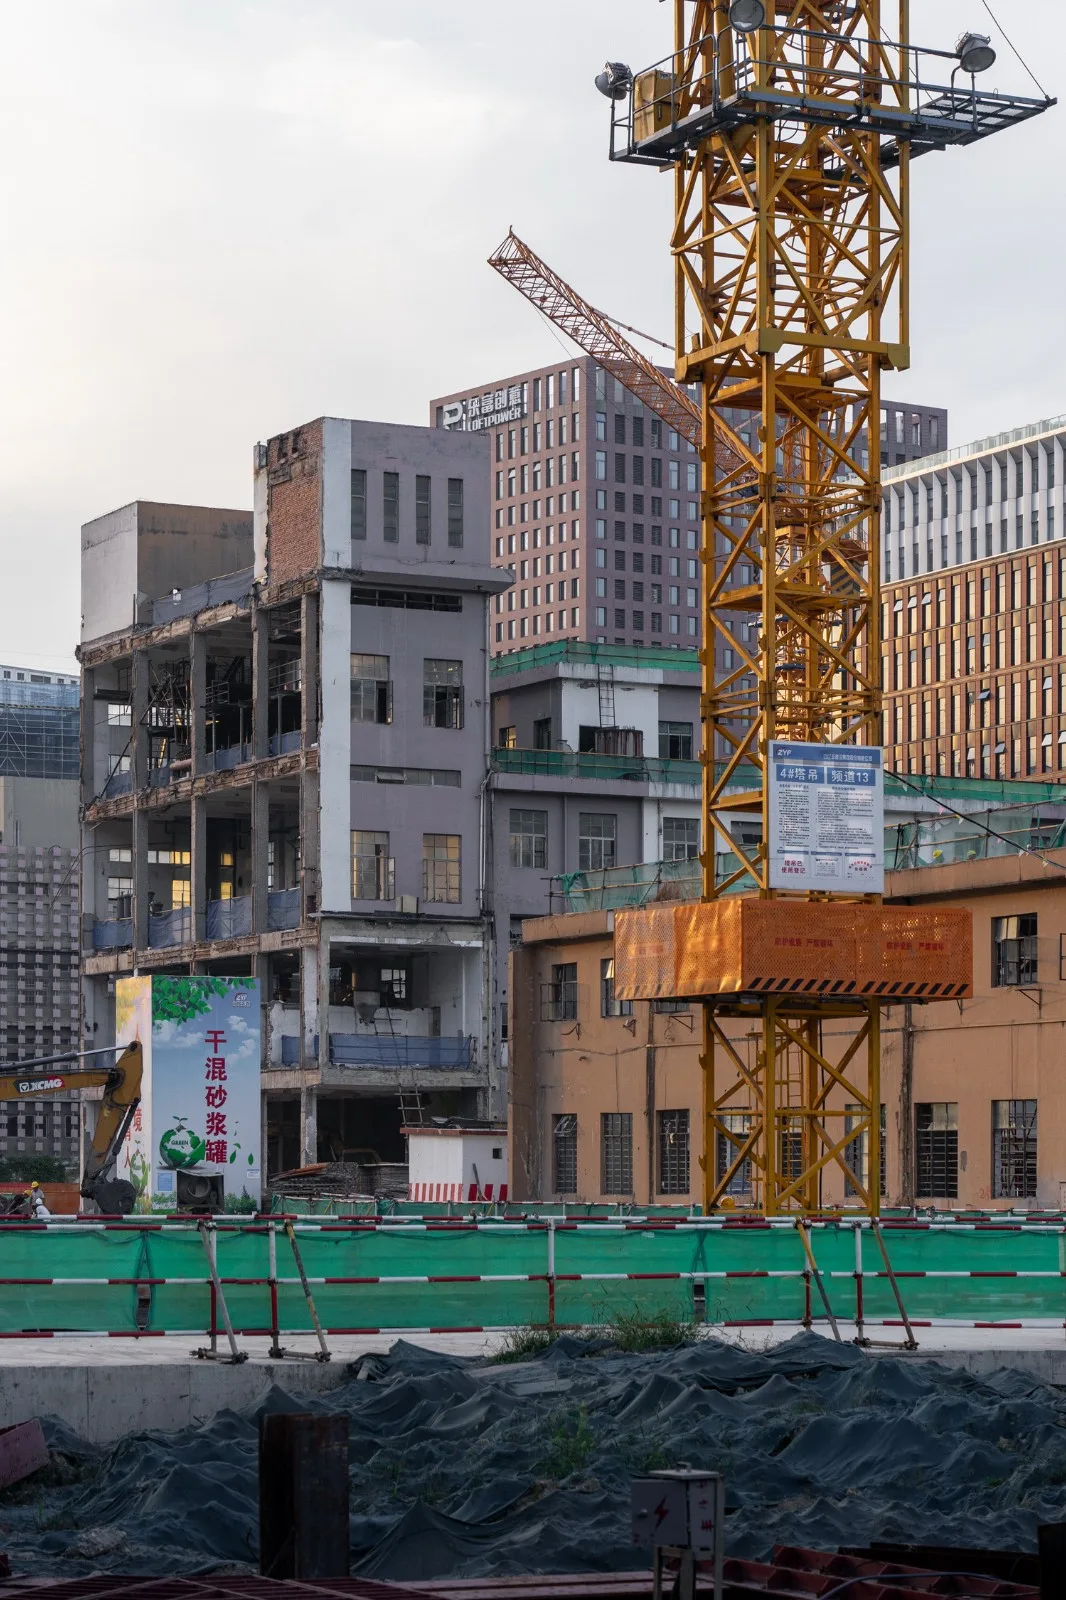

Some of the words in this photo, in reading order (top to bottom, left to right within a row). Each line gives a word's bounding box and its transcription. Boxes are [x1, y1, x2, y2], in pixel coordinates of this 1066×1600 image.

[467, 384, 522, 418] 乐富创意
[467, 406, 522, 432] LOFTPOWER
[780, 768, 818, 781] 4#塔吊
[831, 770, 869, 783] 频道13
[30, 1079, 63, 1091] XCMG
[204, 1030, 228, 1164] 干混砂浆罐
